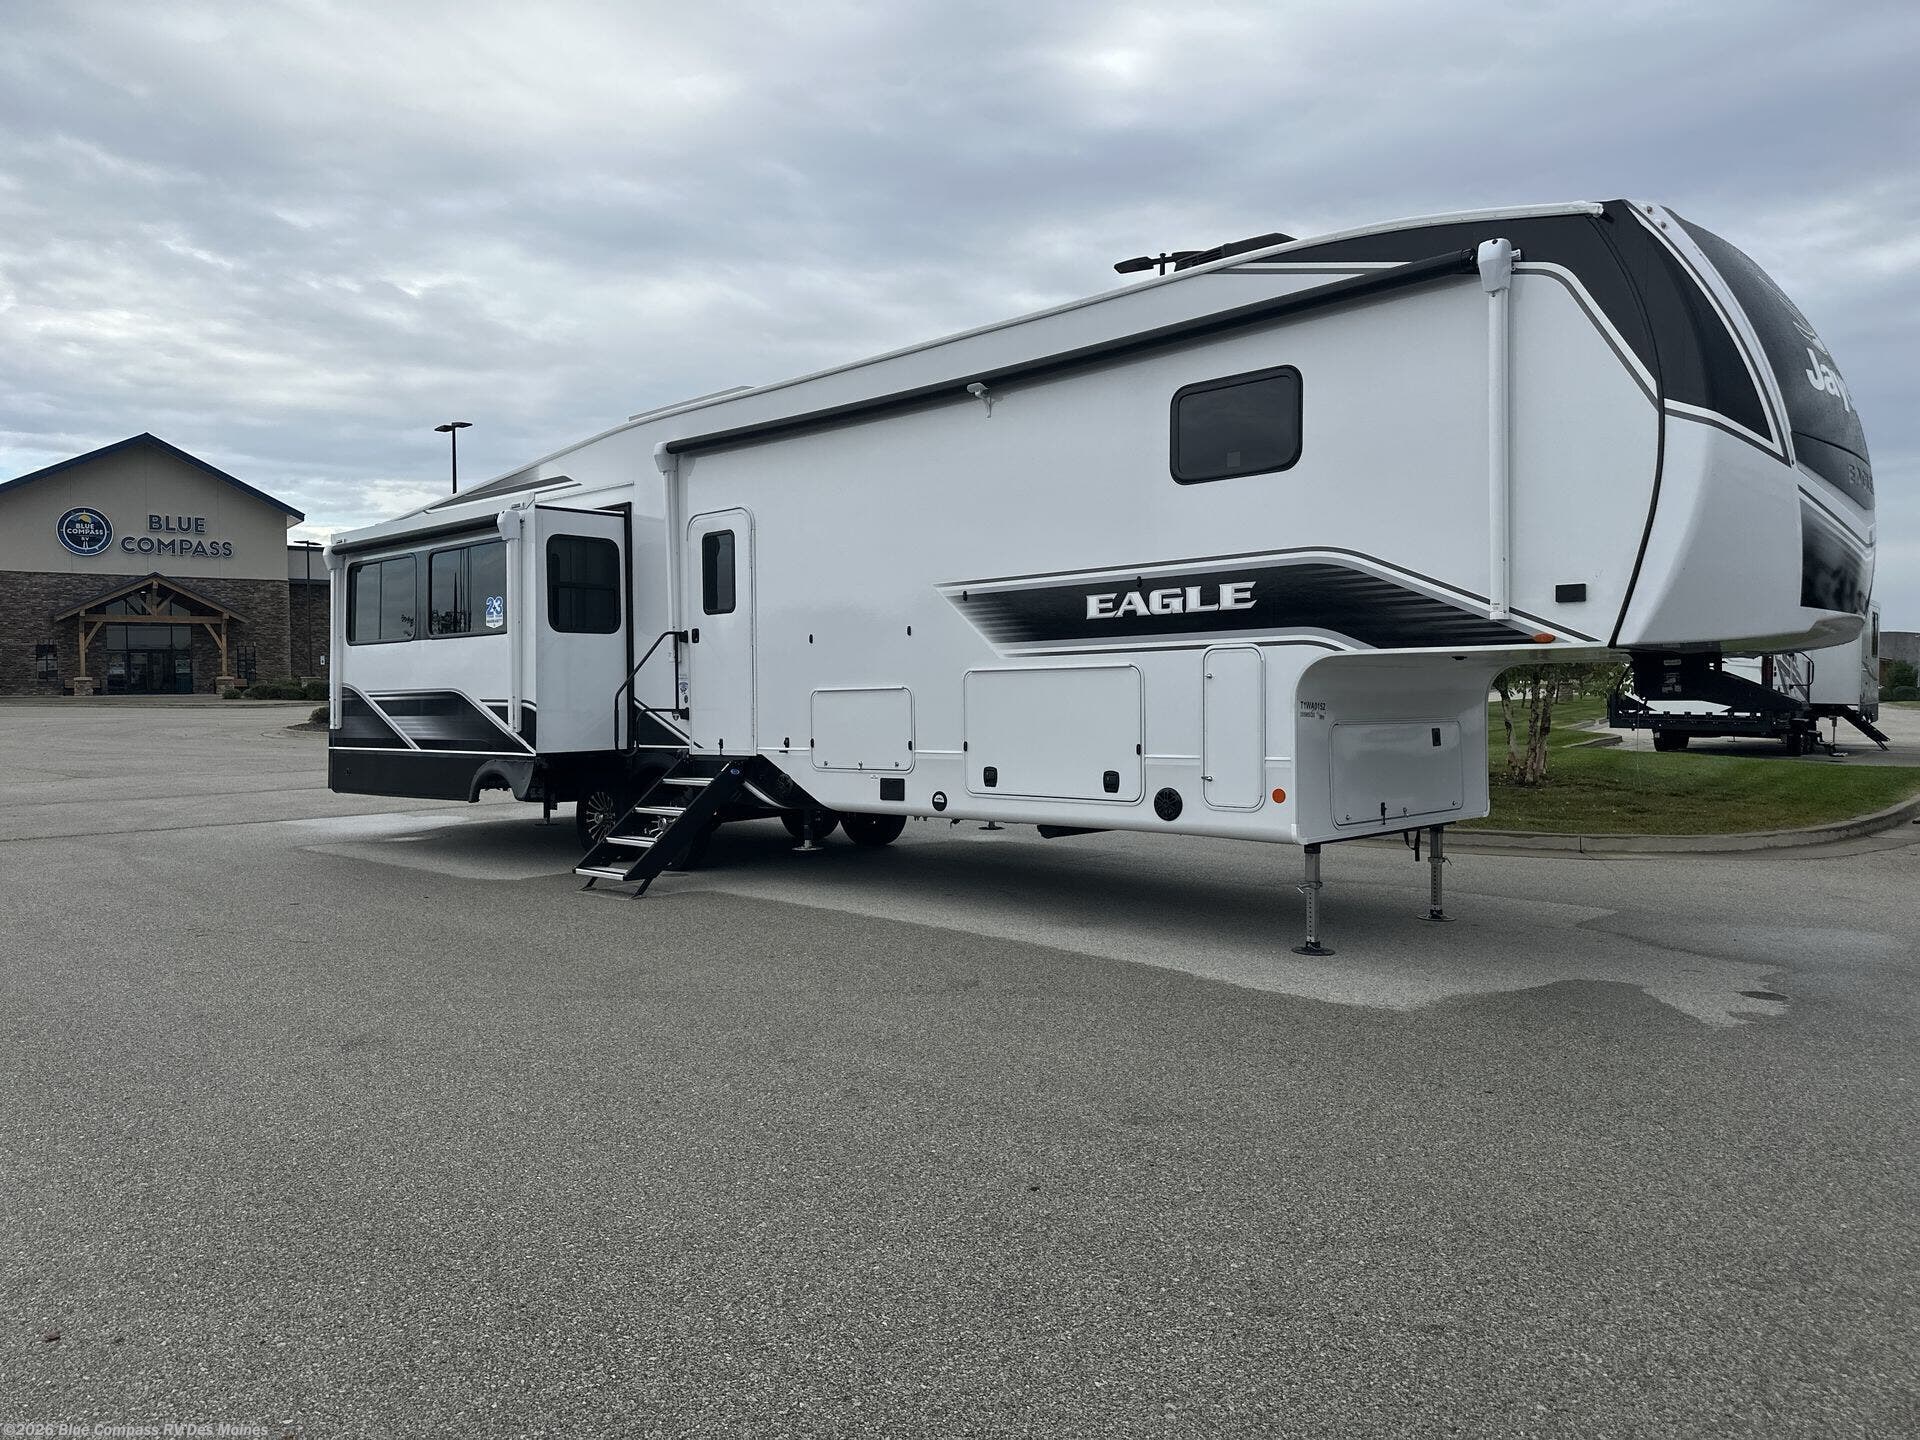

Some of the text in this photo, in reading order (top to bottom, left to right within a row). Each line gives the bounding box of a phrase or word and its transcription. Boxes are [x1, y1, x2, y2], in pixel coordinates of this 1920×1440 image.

[148, 514, 206, 533] BLUE
[120, 536, 233, 558] COMPASS
[1086, 581, 1257, 620] EAGLE
